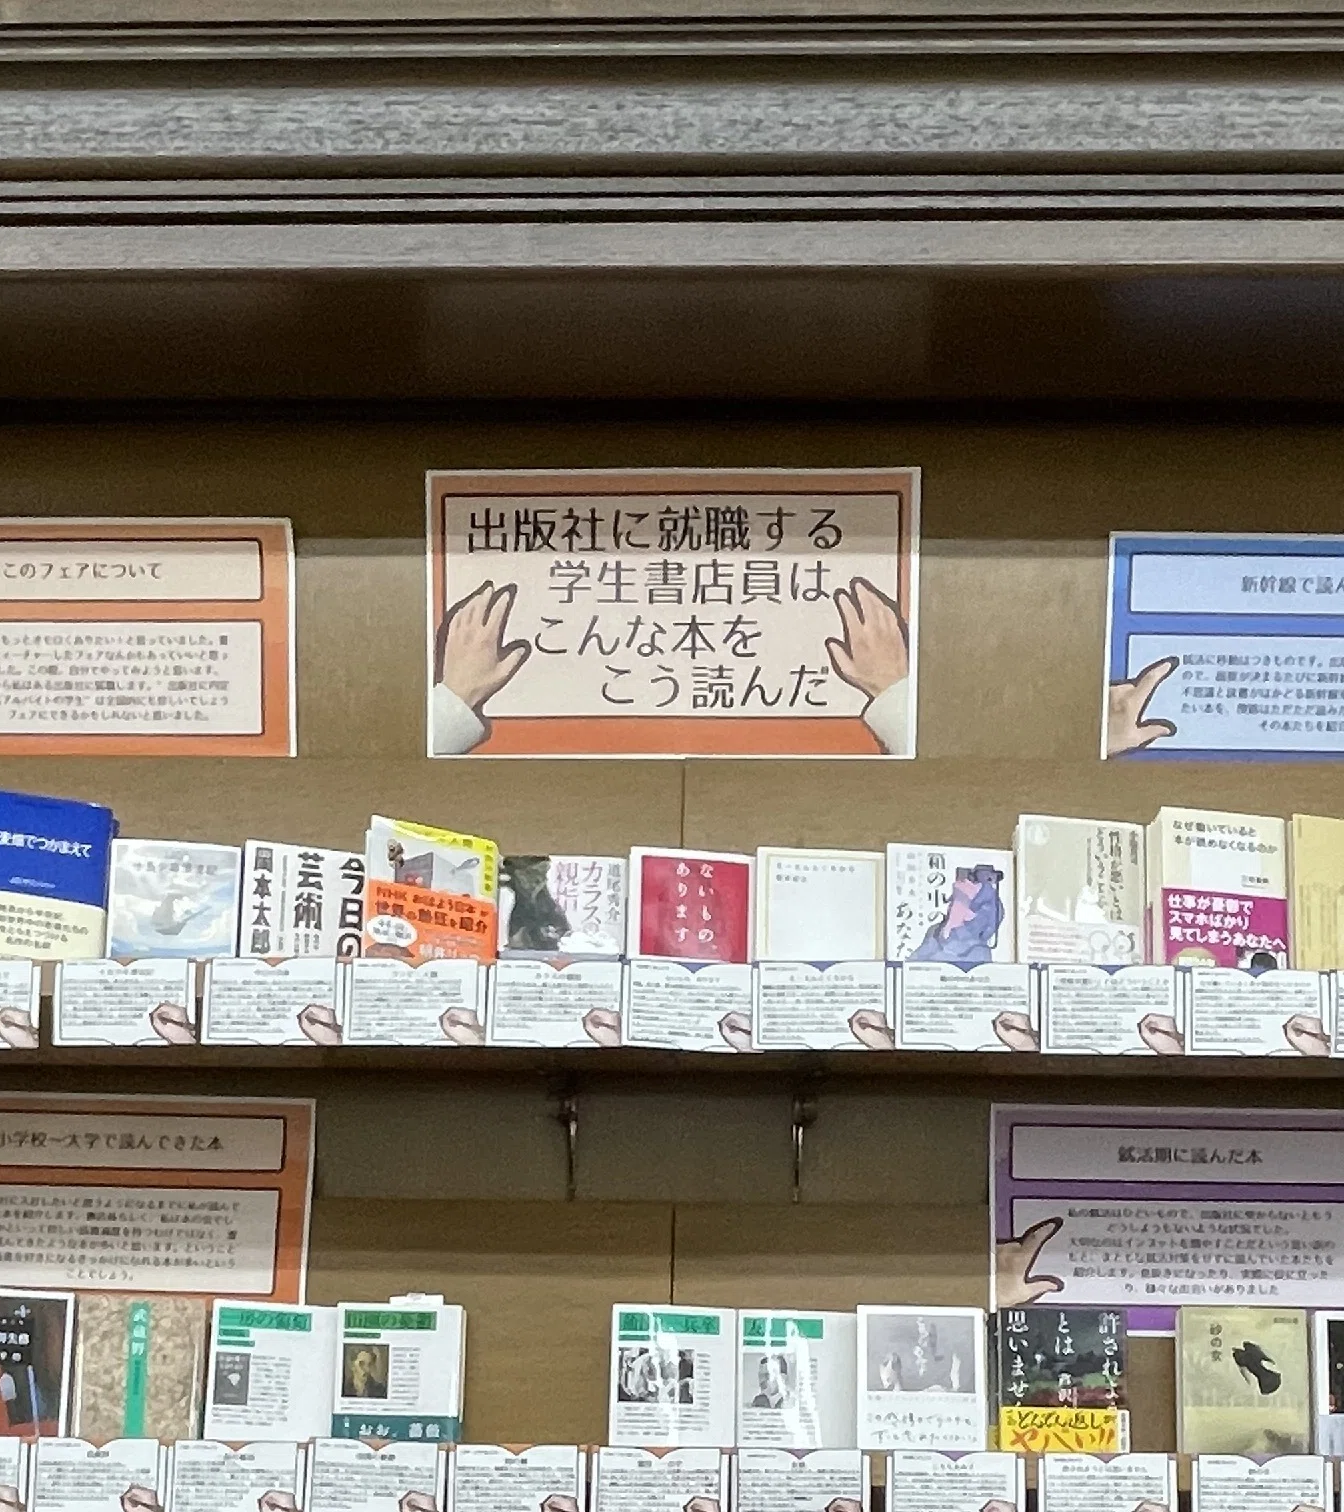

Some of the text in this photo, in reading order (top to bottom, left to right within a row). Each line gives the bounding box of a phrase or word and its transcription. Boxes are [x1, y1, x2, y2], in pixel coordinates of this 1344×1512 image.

[467, 505, 844, 554] 出版社に就職する
[2, 561, 164, 581] このフェアについて
[548, 559, 831, 605] 学生書店員は
[534, 614, 764, 660] こんな本を
[601, 664, 830, 710] こう読んだ
[250, 846, 275, 954] 岡本太郎
[292, 851, 326, 931] 芸術
[674, 861, 692, 943] あります
[927, 852, 951, 924] 箱の中の
[1007, 1310, 1030, 1407] 思いませ
[1055, 1312, 1076, 1356] とは
